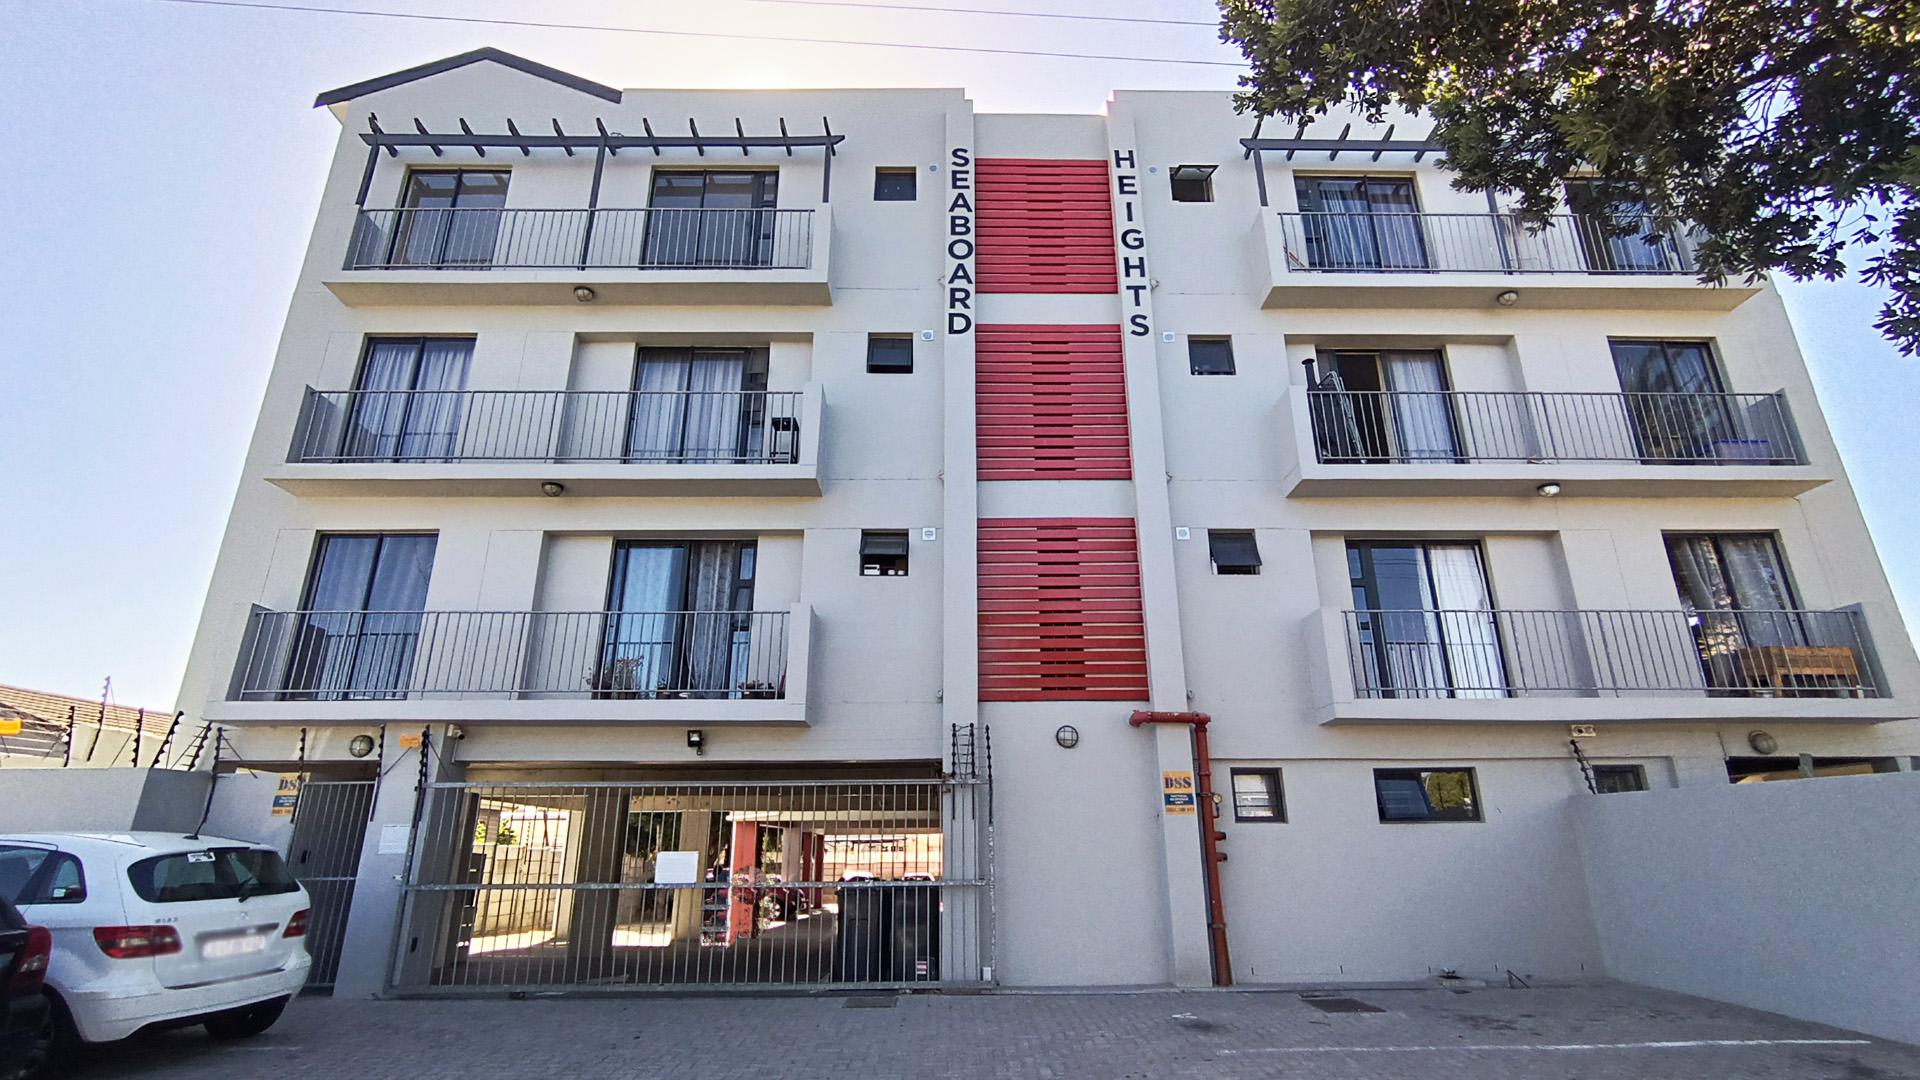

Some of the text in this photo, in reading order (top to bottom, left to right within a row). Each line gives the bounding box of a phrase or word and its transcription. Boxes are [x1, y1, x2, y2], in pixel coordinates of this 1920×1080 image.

[947, 147, 974, 335] SEABOARD
[1113, 149, 1150, 337] HEIGHTS
[1164, 776, 1192, 789] DSS
